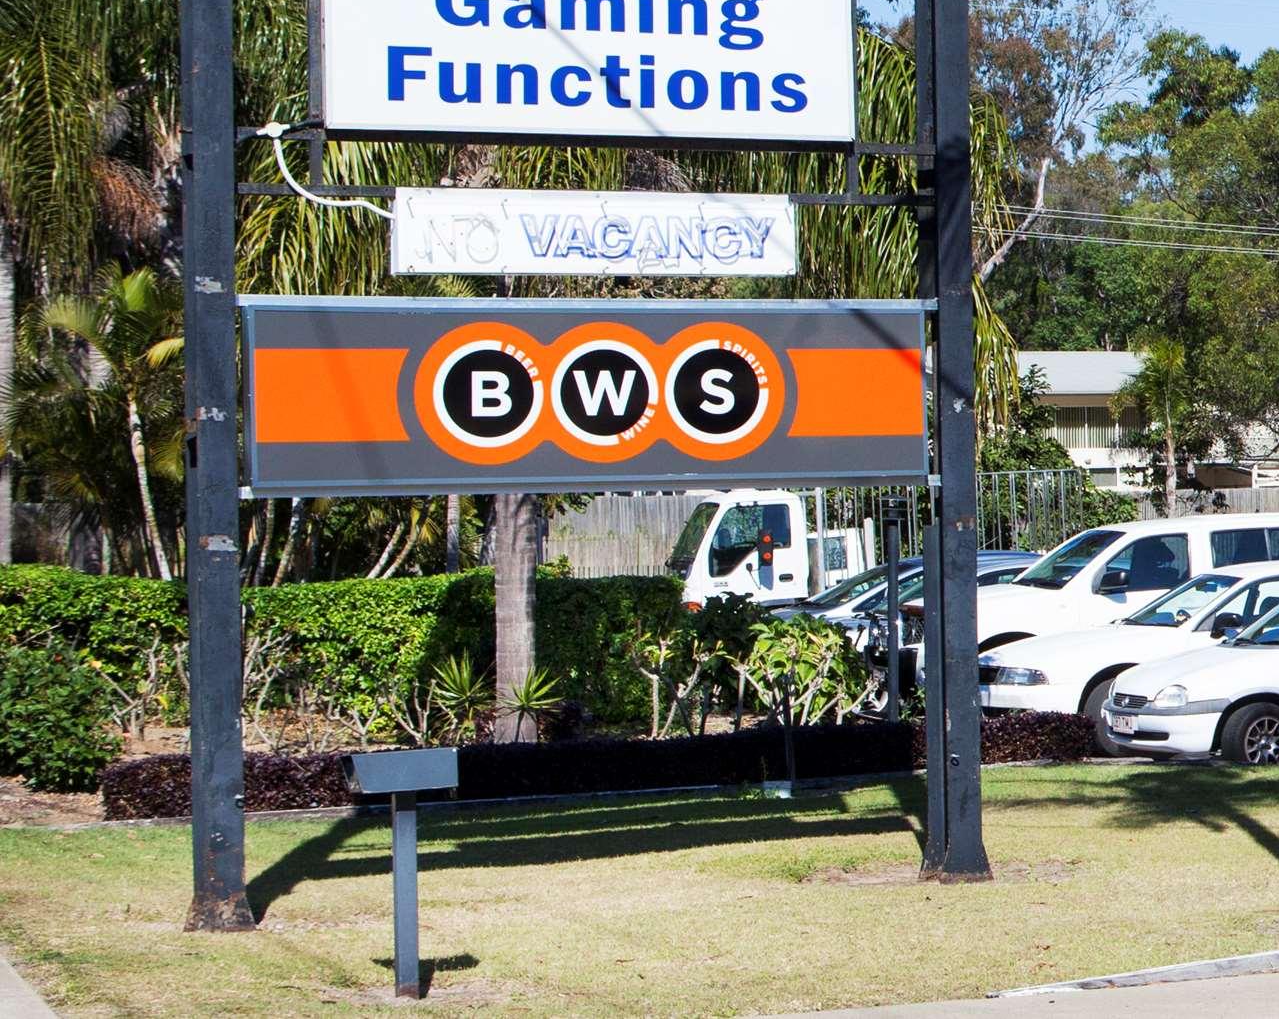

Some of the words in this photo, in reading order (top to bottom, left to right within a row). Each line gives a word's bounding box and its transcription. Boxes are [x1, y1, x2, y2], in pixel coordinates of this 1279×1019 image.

[387, 45, 809, 113] Functions
[416, 214, 499, 263] NO
[518, 213, 776, 267] VACANCY
[505, 344, 540, 380] BEER
[723, 340, 768, 386] SPIRITS
[622, 404, 657, 442] WINE
